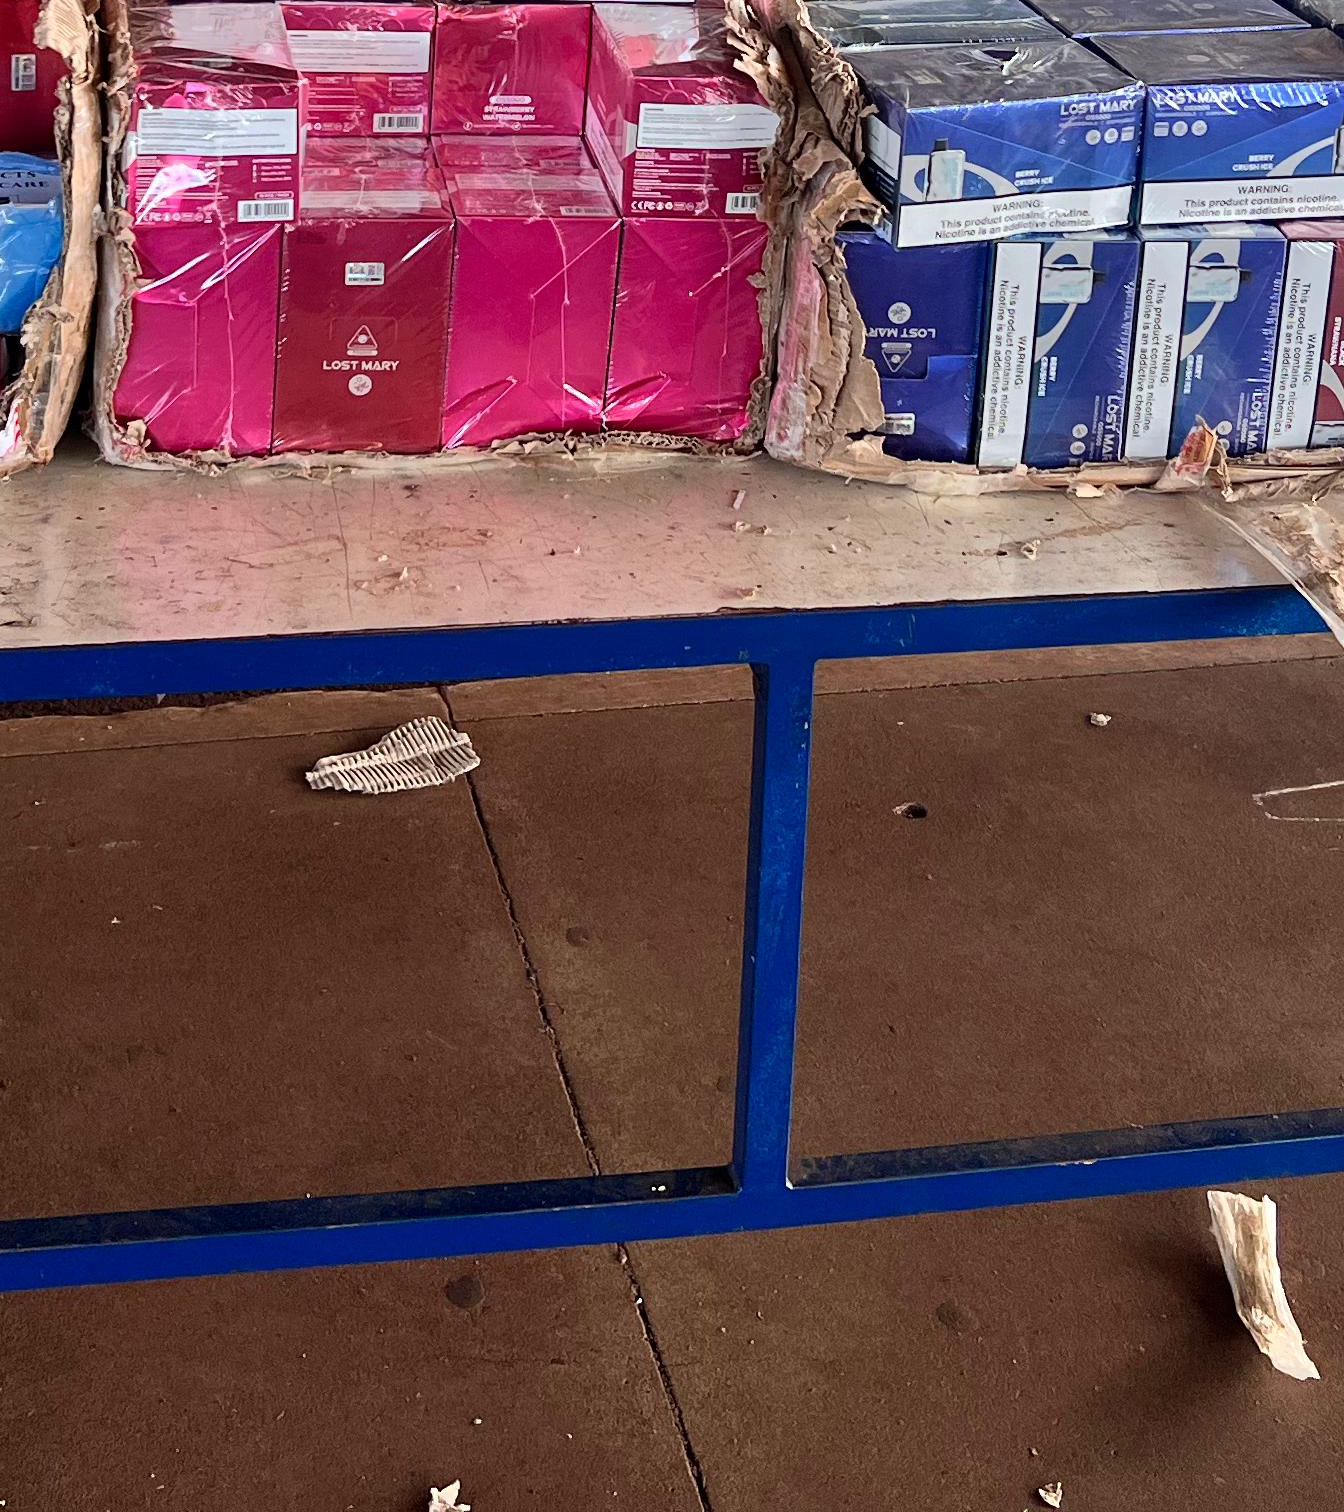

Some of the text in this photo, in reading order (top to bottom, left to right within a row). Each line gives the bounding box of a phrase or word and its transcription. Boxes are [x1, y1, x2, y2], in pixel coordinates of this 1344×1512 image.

[1060, 99, 1136, 115] LOST MARY
[993, 200, 1043, 212] WARNING:
[1184, 199, 1206, 207] This
[1209, 198, 1249, 208] product
[1251, 196, 1293, 205] contains
[1178, 209, 1220, 218] Nicotine
[1224, 208, 1232, 216] is
[1249, 206, 1295, 215] addictive
[941, 212, 1044, 228] This product contains
[935, 231, 975, 239] Nicotine
[989, 226, 1001, 235] an
[1003, 221, 1046, 233] addictive
[868, 327, 936, 338] LOST MAR
[323, 360, 400, 371] LOST MARY
[1105, 395, 1119, 431] LOST
